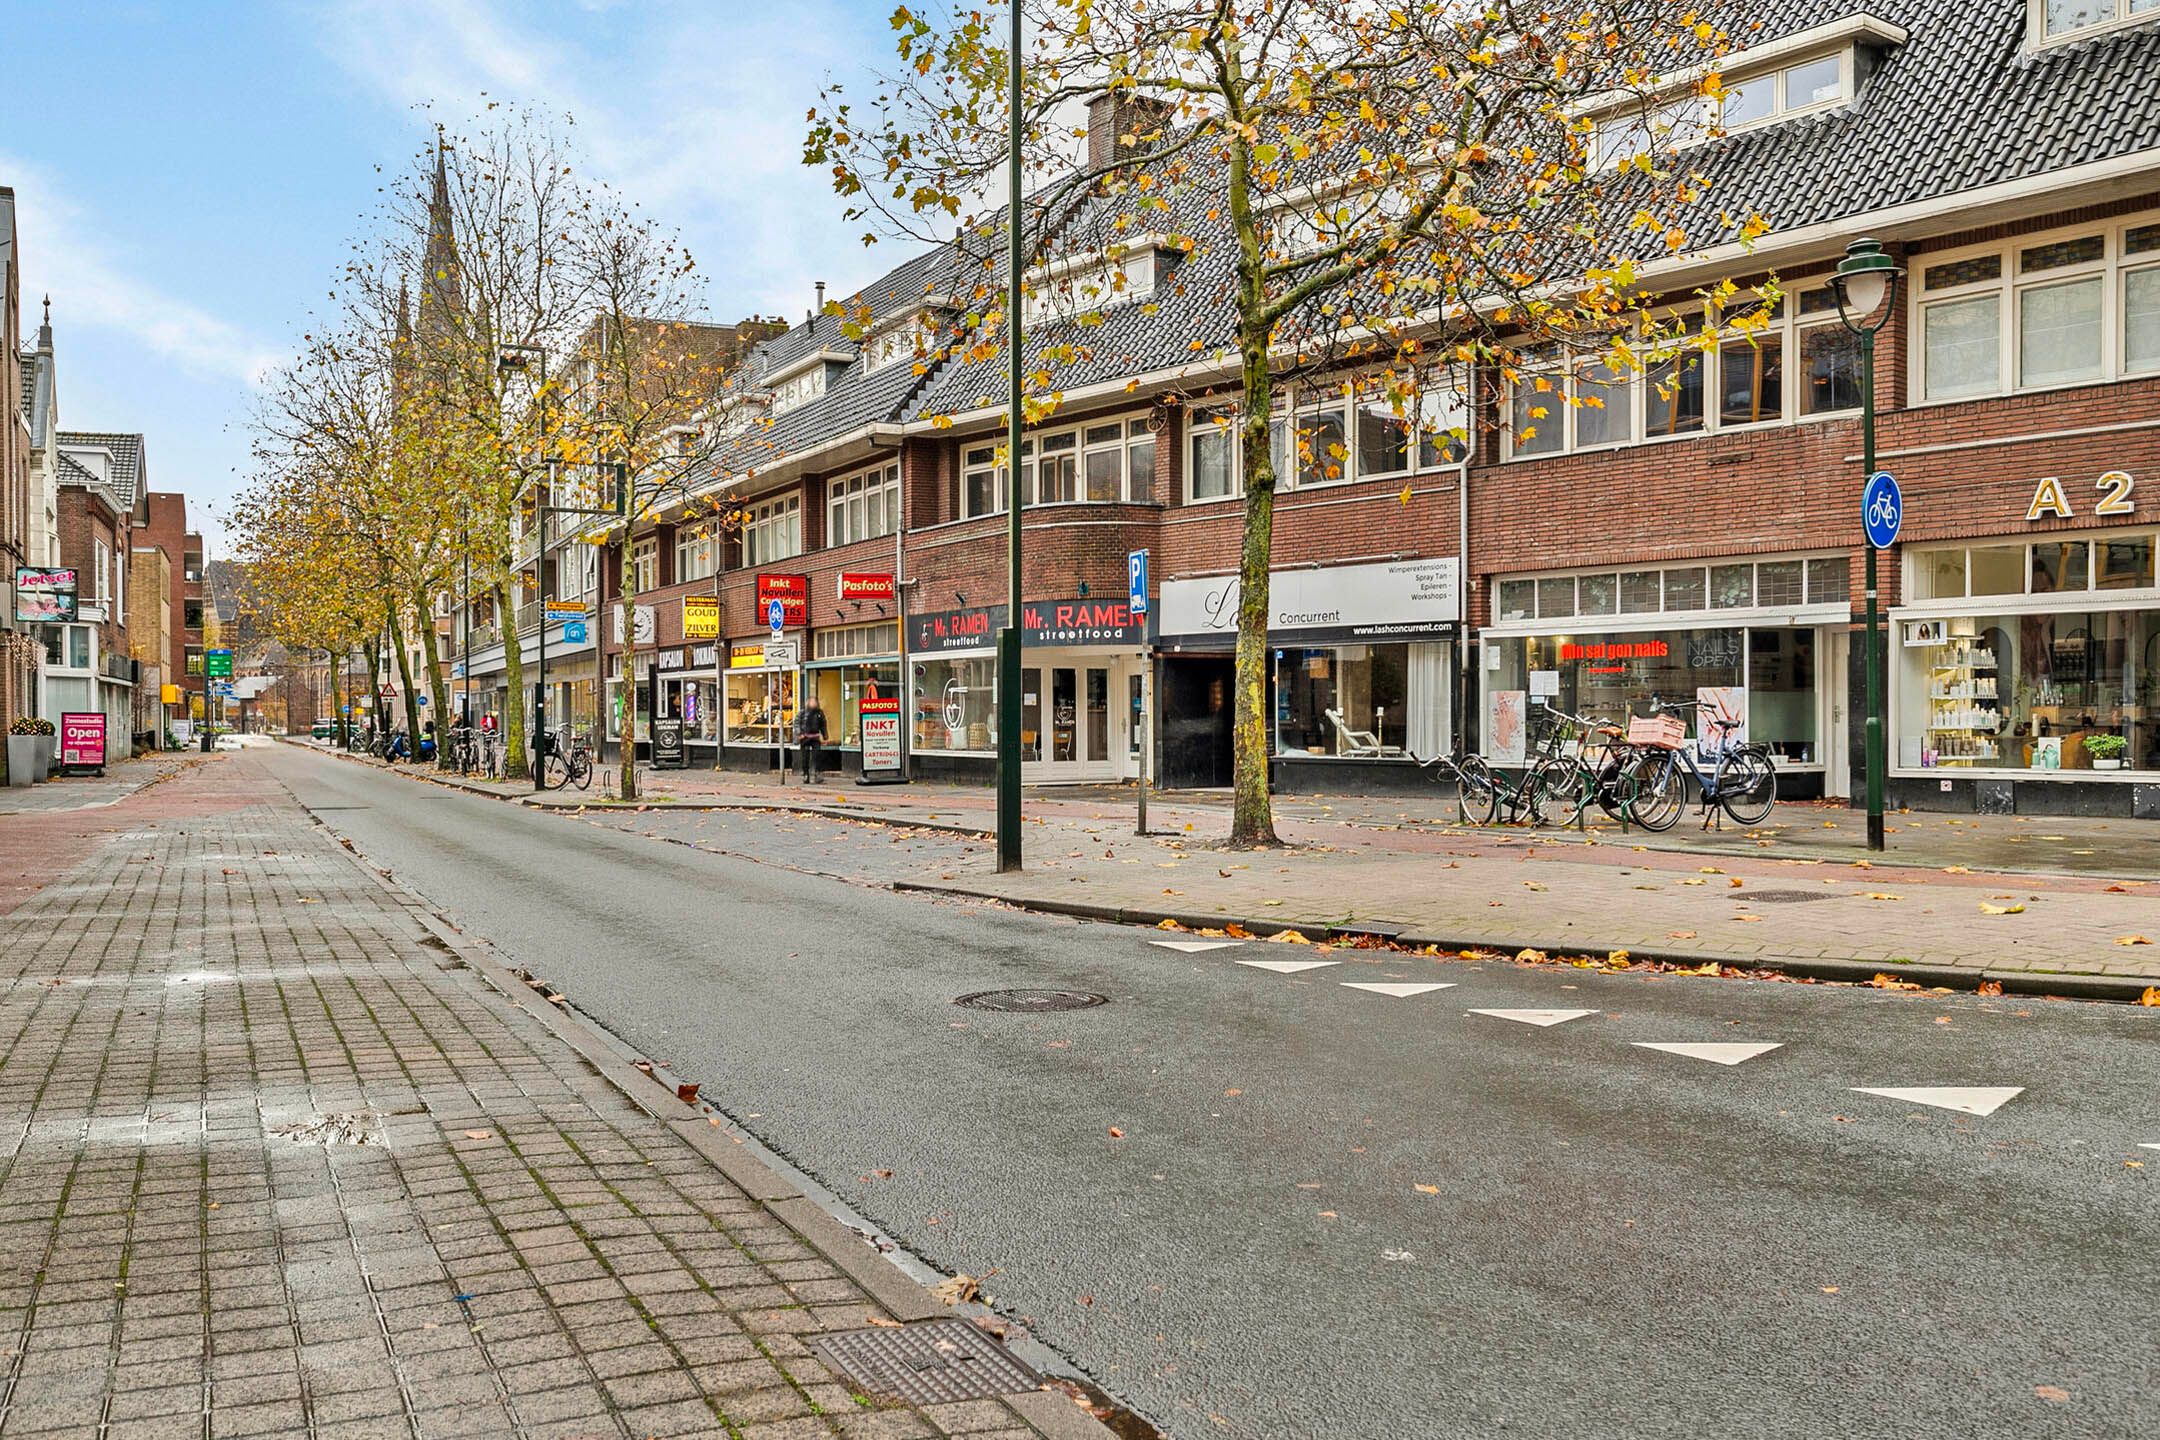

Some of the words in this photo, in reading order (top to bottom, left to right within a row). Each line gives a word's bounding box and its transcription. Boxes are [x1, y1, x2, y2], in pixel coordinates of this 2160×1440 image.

[1131, 558, 1141, 588] P
[1388, 563, 1447, 573] Wimperextensions
[19, 570, 74, 587] Jetset
[770, 579, 791, 588] Inkt
[1415, 574, 1434, 582] Spray
[843, 580, 893, 591] Pasfoto's
[761, 588, 803, 597] Navullen
[1411, 593, 1447, 601] Workshops
[687, 608, 717, 617] GOUD
[1024, 607, 1048, 630] Mr.
[1279, 611, 1340, 624] Concurrent
[687, 623, 717, 632] ZILVER
[934, 617, 948, 637] Mr.
[951, 613, 989, 636] RAMEN
[1353, 623, 1452, 635] www.lashconcurrent.com
[1039, 628, 1123, 640] streetfood
[943, 635, 980, 647] streetfood
[1607, 644, 1633, 660] gon
[1633, 639, 1668, 656] nails
[1687, 640, 1740, 655] NAILS
[1692, 655, 1736, 667] OPEN
[865, 720, 896, 730] INKT
[67, 727, 101, 740] Open
